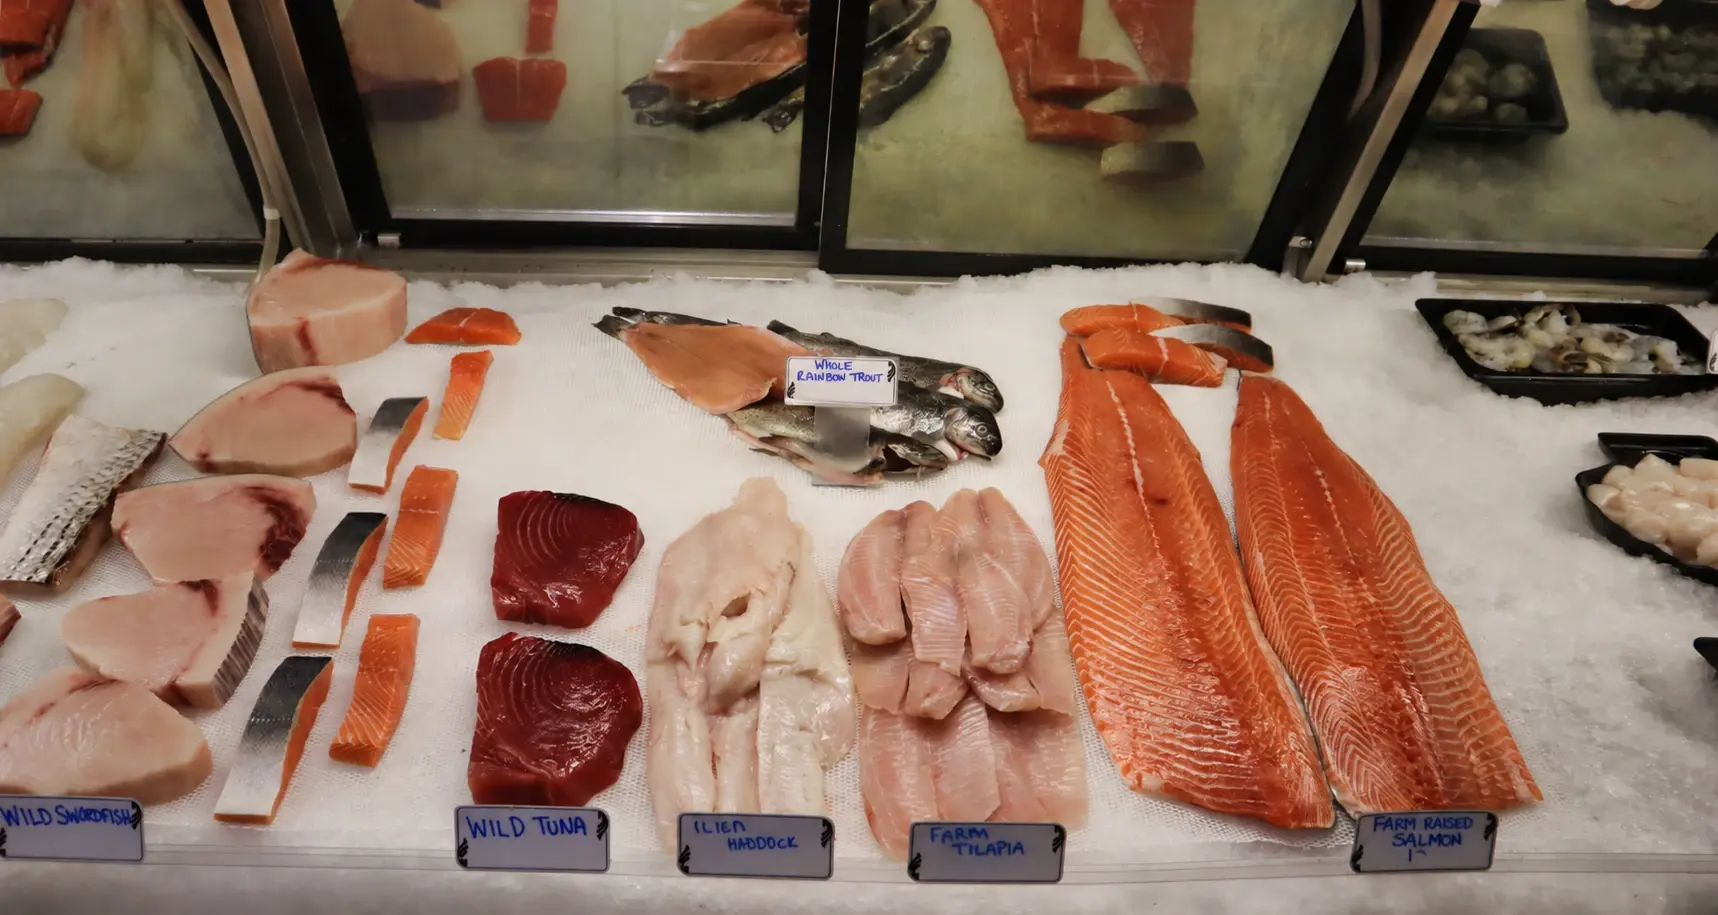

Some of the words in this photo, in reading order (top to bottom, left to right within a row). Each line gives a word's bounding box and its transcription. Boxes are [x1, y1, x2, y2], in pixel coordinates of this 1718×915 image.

[815, 359, 852, 371] WHOLE
[797, 370, 846, 382] RAINBOW
[849, 372, 883, 382] TROUT
[0, 804, 52, 827] WILD
[55, 804, 133, 826] SWORDFISH
[465, 815, 526, 839] WILD
[532, 815, 588, 837] TUNA
[1373, 816, 1416, 832] FARM
[1424, 816, 1473, 831] RAISED
[930, 827, 990, 843] FARM
[1392, 832, 1462, 848] SALMON
[727, 836, 799, 852] HADDOCK
[952, 841, 1026, 857] TILAPIA
